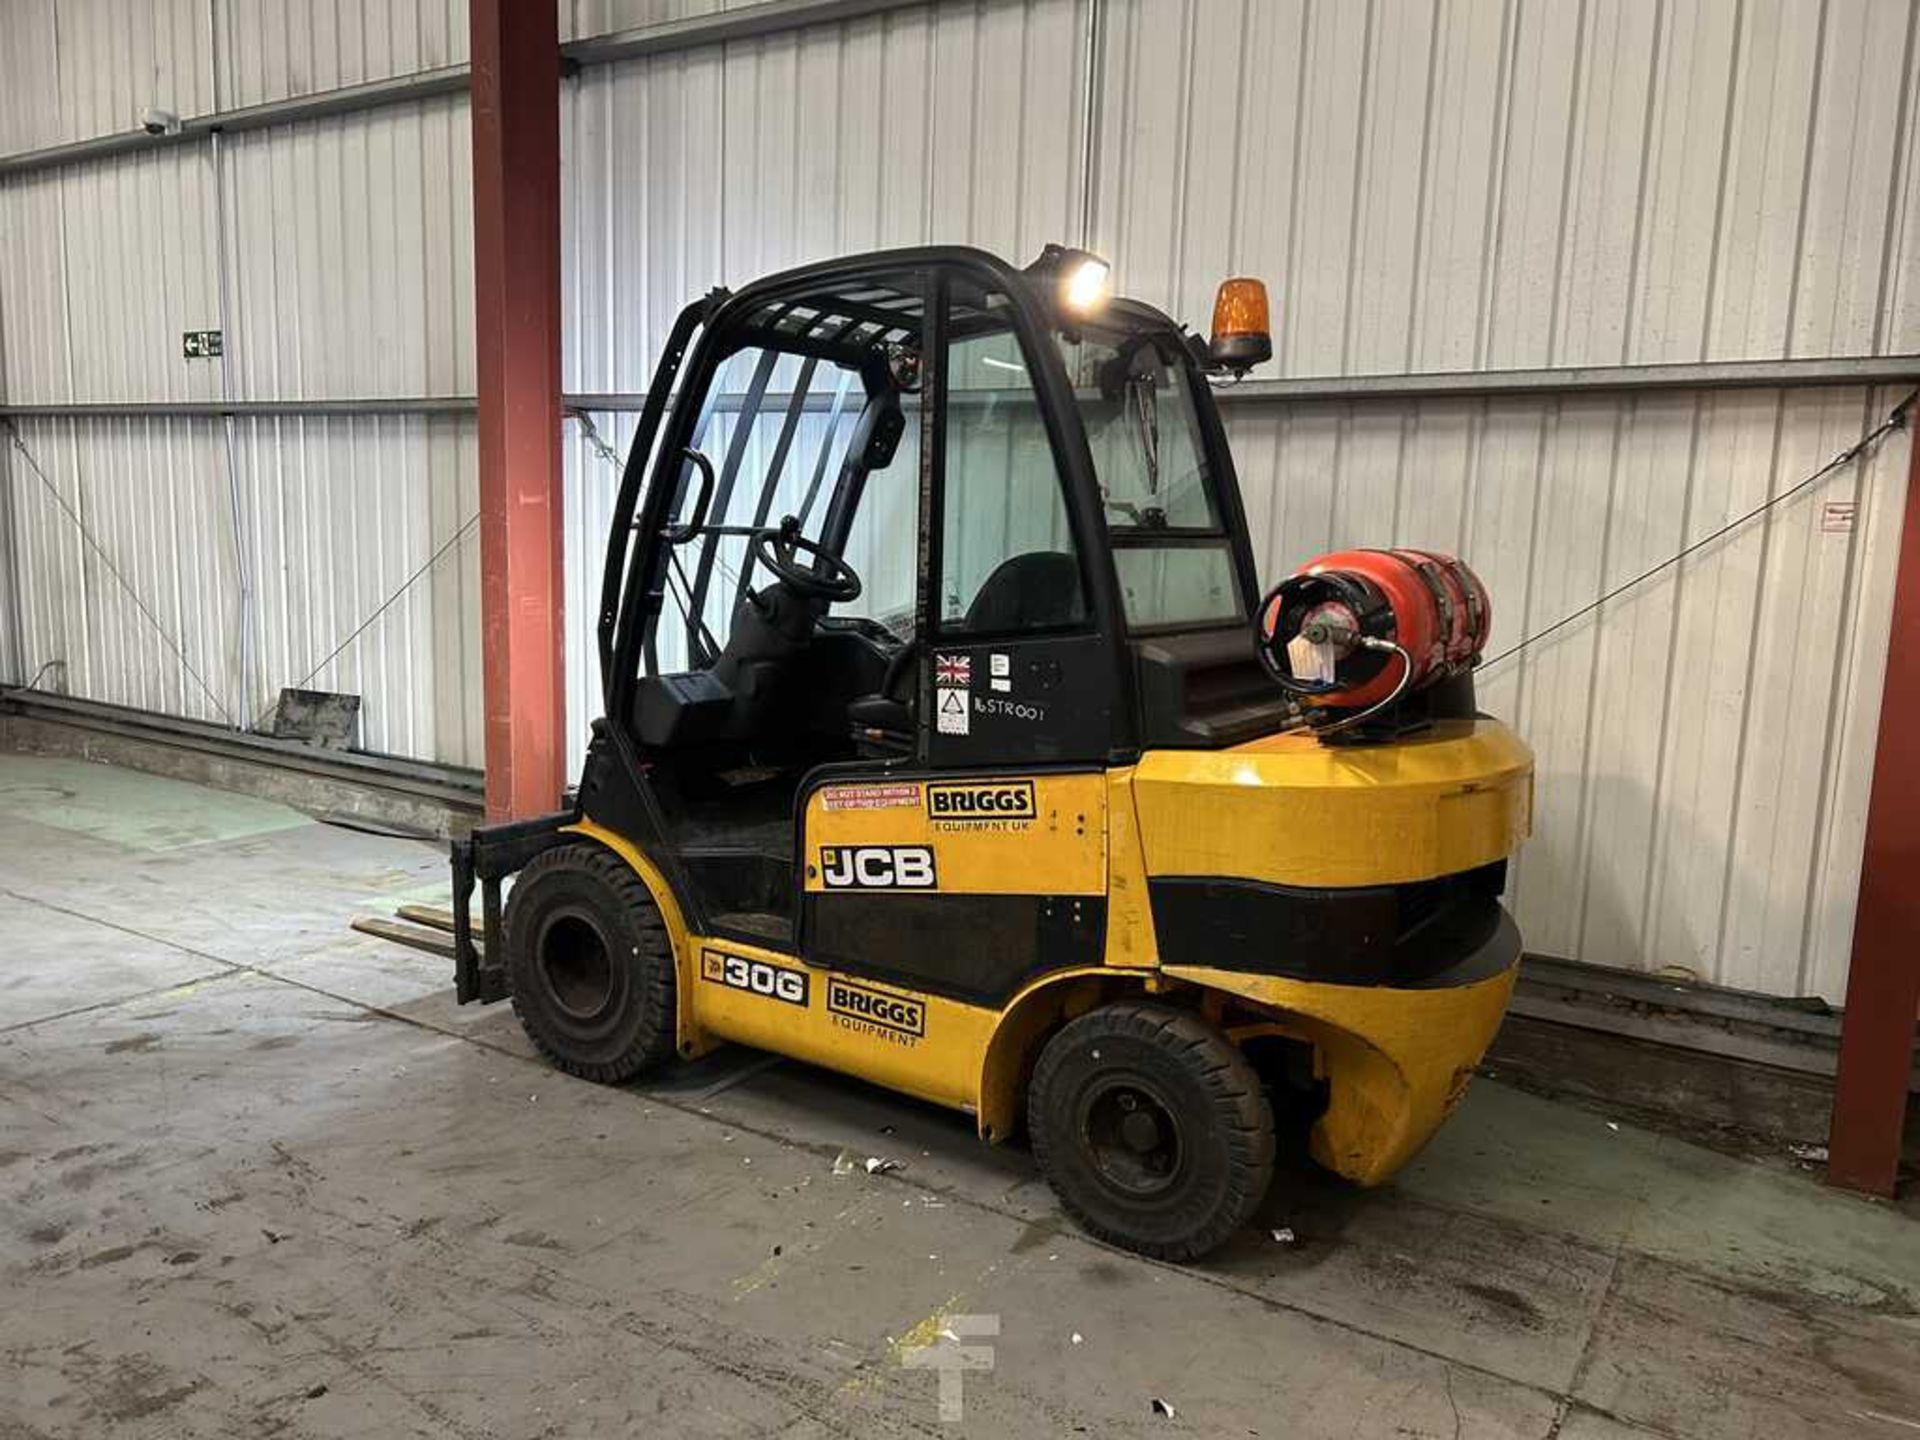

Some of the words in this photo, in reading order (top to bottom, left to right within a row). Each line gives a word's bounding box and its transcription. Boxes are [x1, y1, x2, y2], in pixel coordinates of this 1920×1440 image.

[856, 789, 881, 797] STAND
[933, 790, 1028, 812] BRIGGS
[935, 821, 1008, 832] EQUIPMENT
[1012, 821, 1029, 831] UK
[824, 849, 935, 886] JCB
[725, 956, 803, 1002] 30G
[833, 987, 919, 1027] BRIGGS
[832, 1014, 918, 1048] EQUIPMENT
